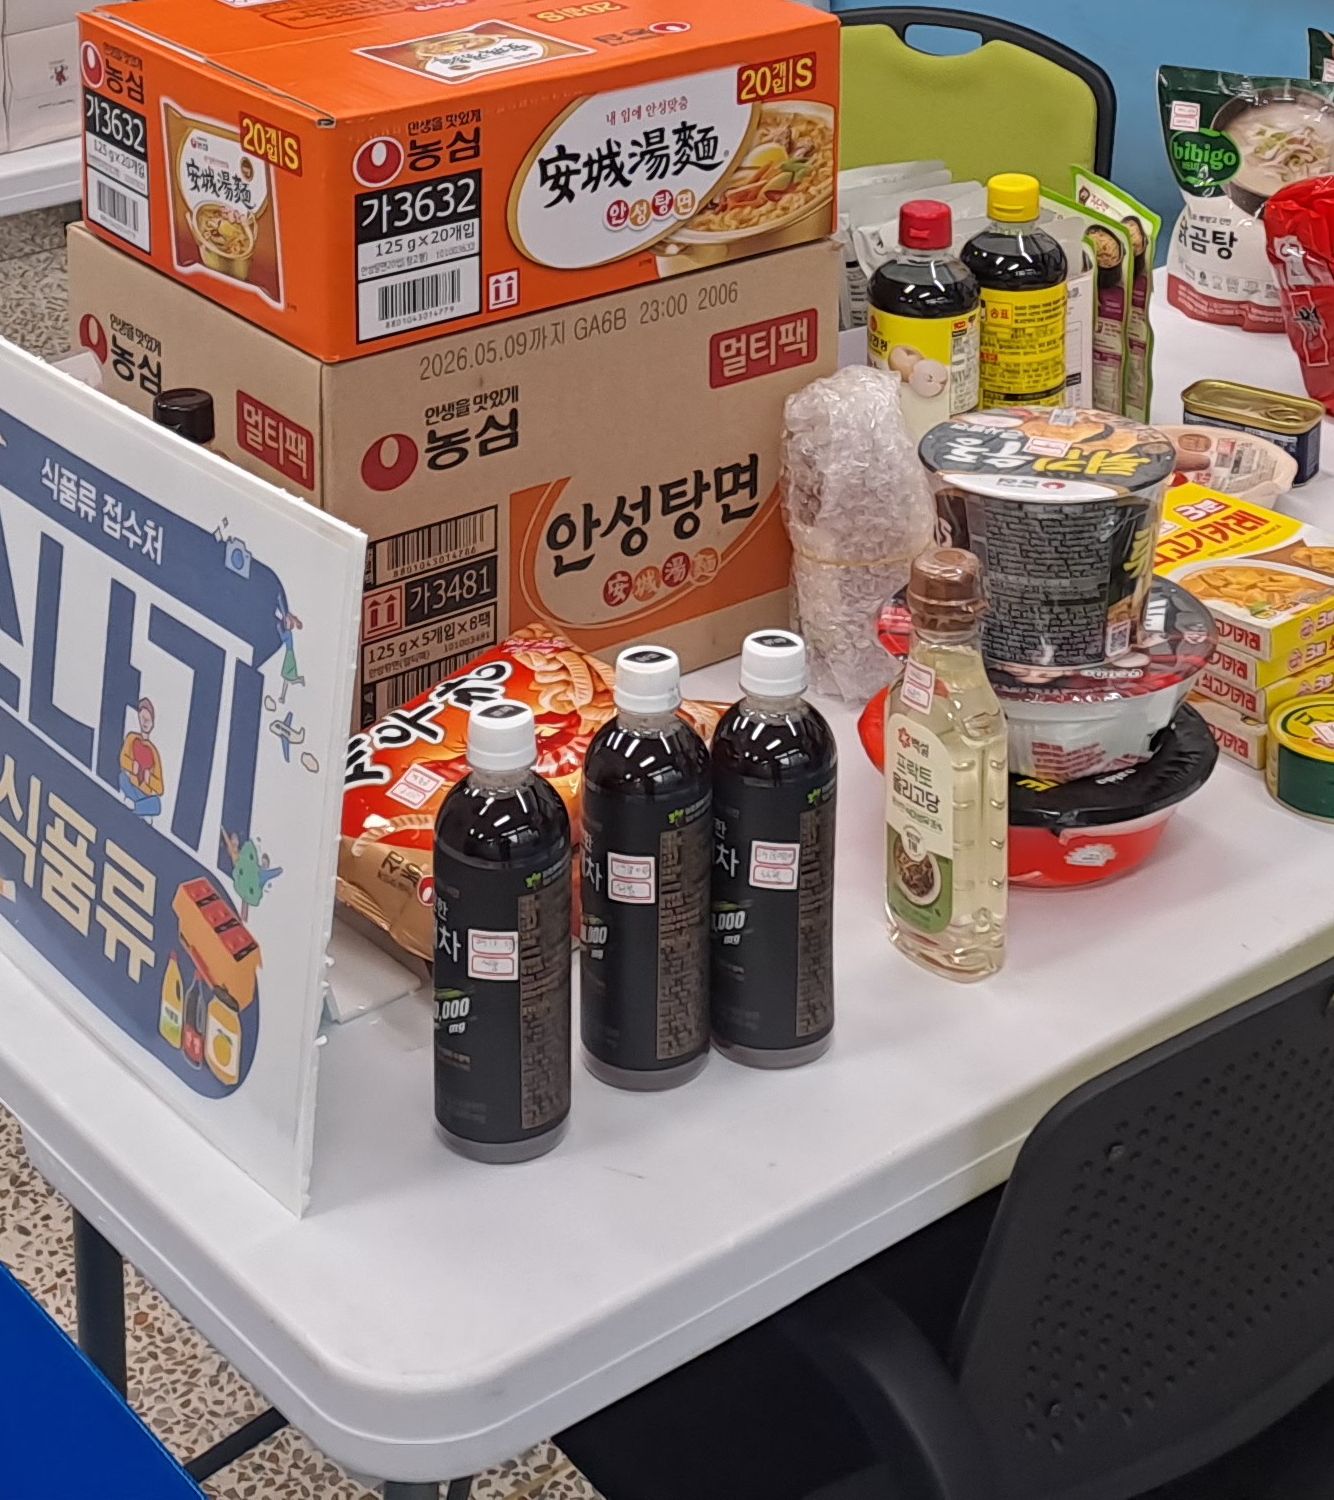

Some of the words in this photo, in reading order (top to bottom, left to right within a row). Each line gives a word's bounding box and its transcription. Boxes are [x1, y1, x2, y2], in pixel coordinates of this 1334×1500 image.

[105, 58, 145, 105] 농심
[621, 107, 643, 124] 입에
[646, 95, 688, 118] 안성맞춤
[86, 93, 146, 154] 가3632
[407, 127, 481, 172] 농심
[538, 121, 724, 209] 安城湯麵
[1173, 141, 1237, 171] bibigo
[361, 177, 477, 233] 가3632
[608, 190, 696, 226] 안성탕면
[419, 319, 566, 381] 2026.05.09까지
[574, 306, 627, 343] GA6B
[640, 294, 688, 325] 23:00
[699, 281, 739, 311] 2006
[719, 317, 809, 379] 멀티팩
[424, 398, 471, 426] 인생을
[472, 385, 519, 415] 맛있게
[241, 399, 310, 482] 멀티팩
[424, 407, 519, 470] 농심
[41, 456, 96, 523] 식품류
[101, 492, 163, 568] 접수처
[546, 452, 762, 578] 안성탕면
[410, 565, 492, 615] 가3481
[896, 751, 933, 790] 프락토
